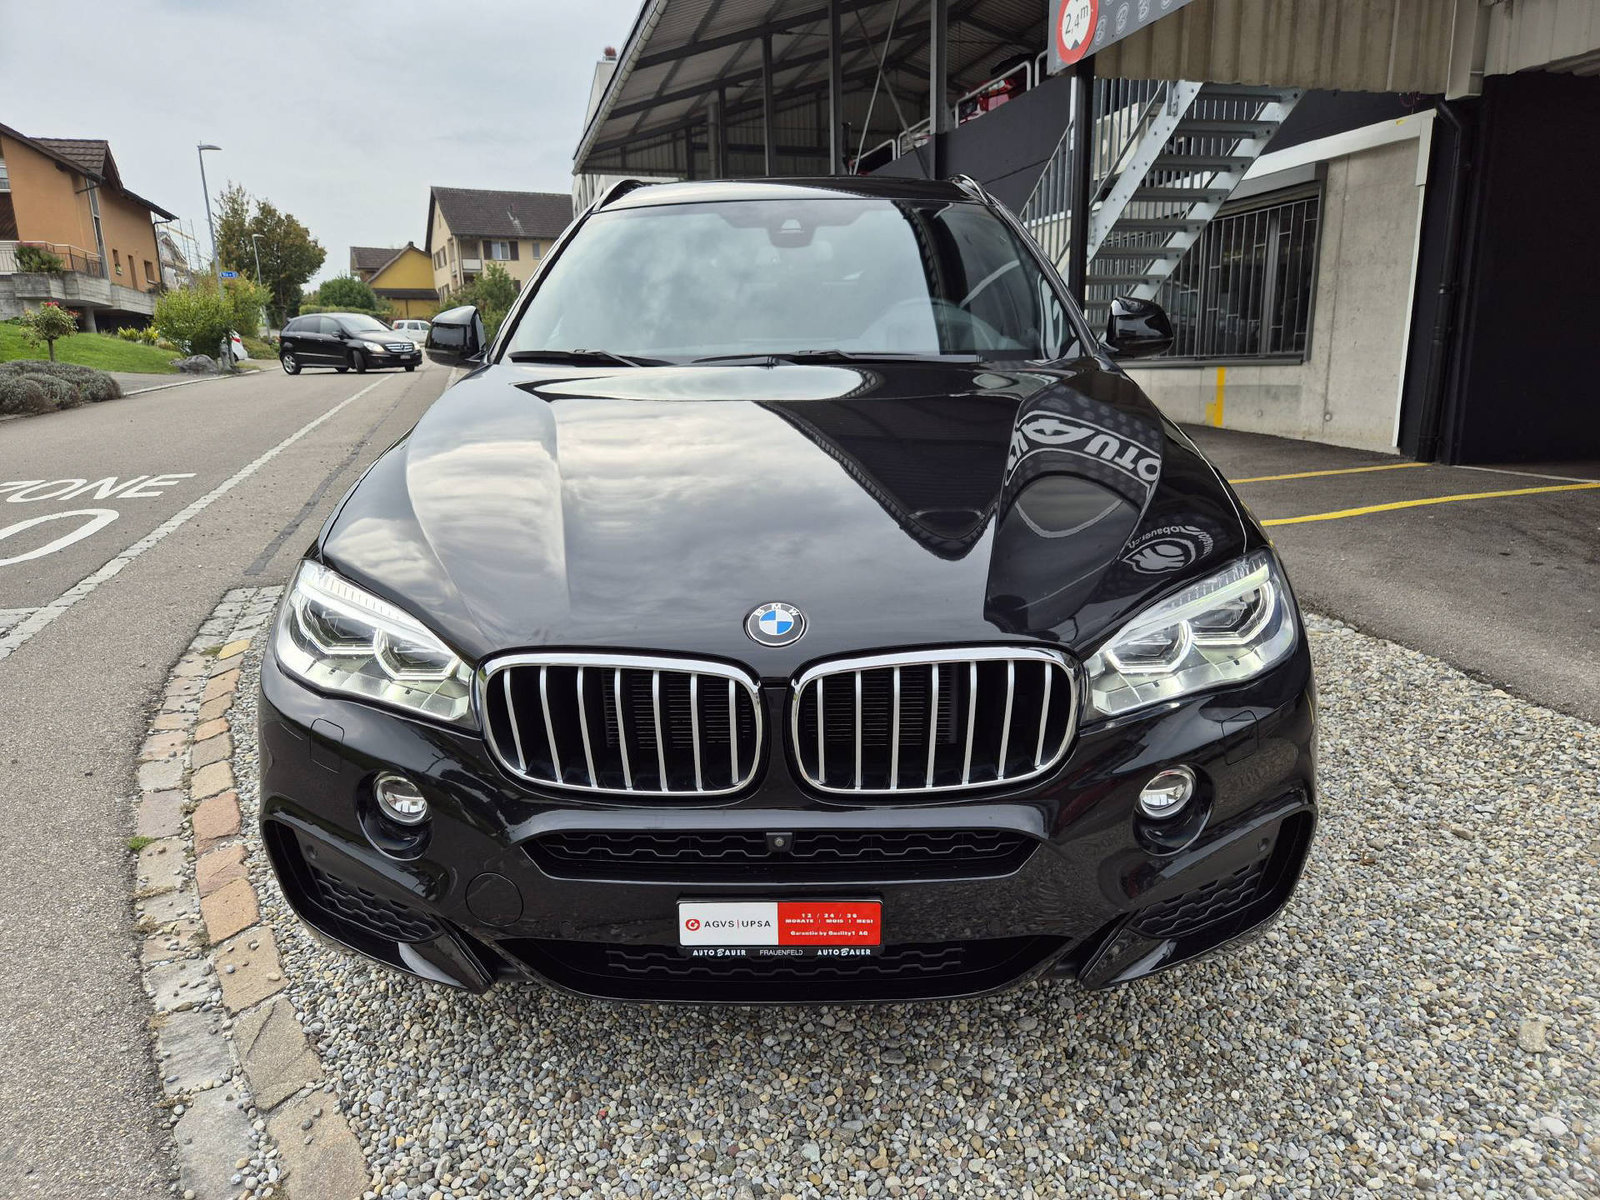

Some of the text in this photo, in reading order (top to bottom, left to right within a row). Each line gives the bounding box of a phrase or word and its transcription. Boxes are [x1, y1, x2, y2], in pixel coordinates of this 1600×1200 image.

[754, 603, 800, 616] BMW
[704, 920, 771, 928] AGVS UPSA
